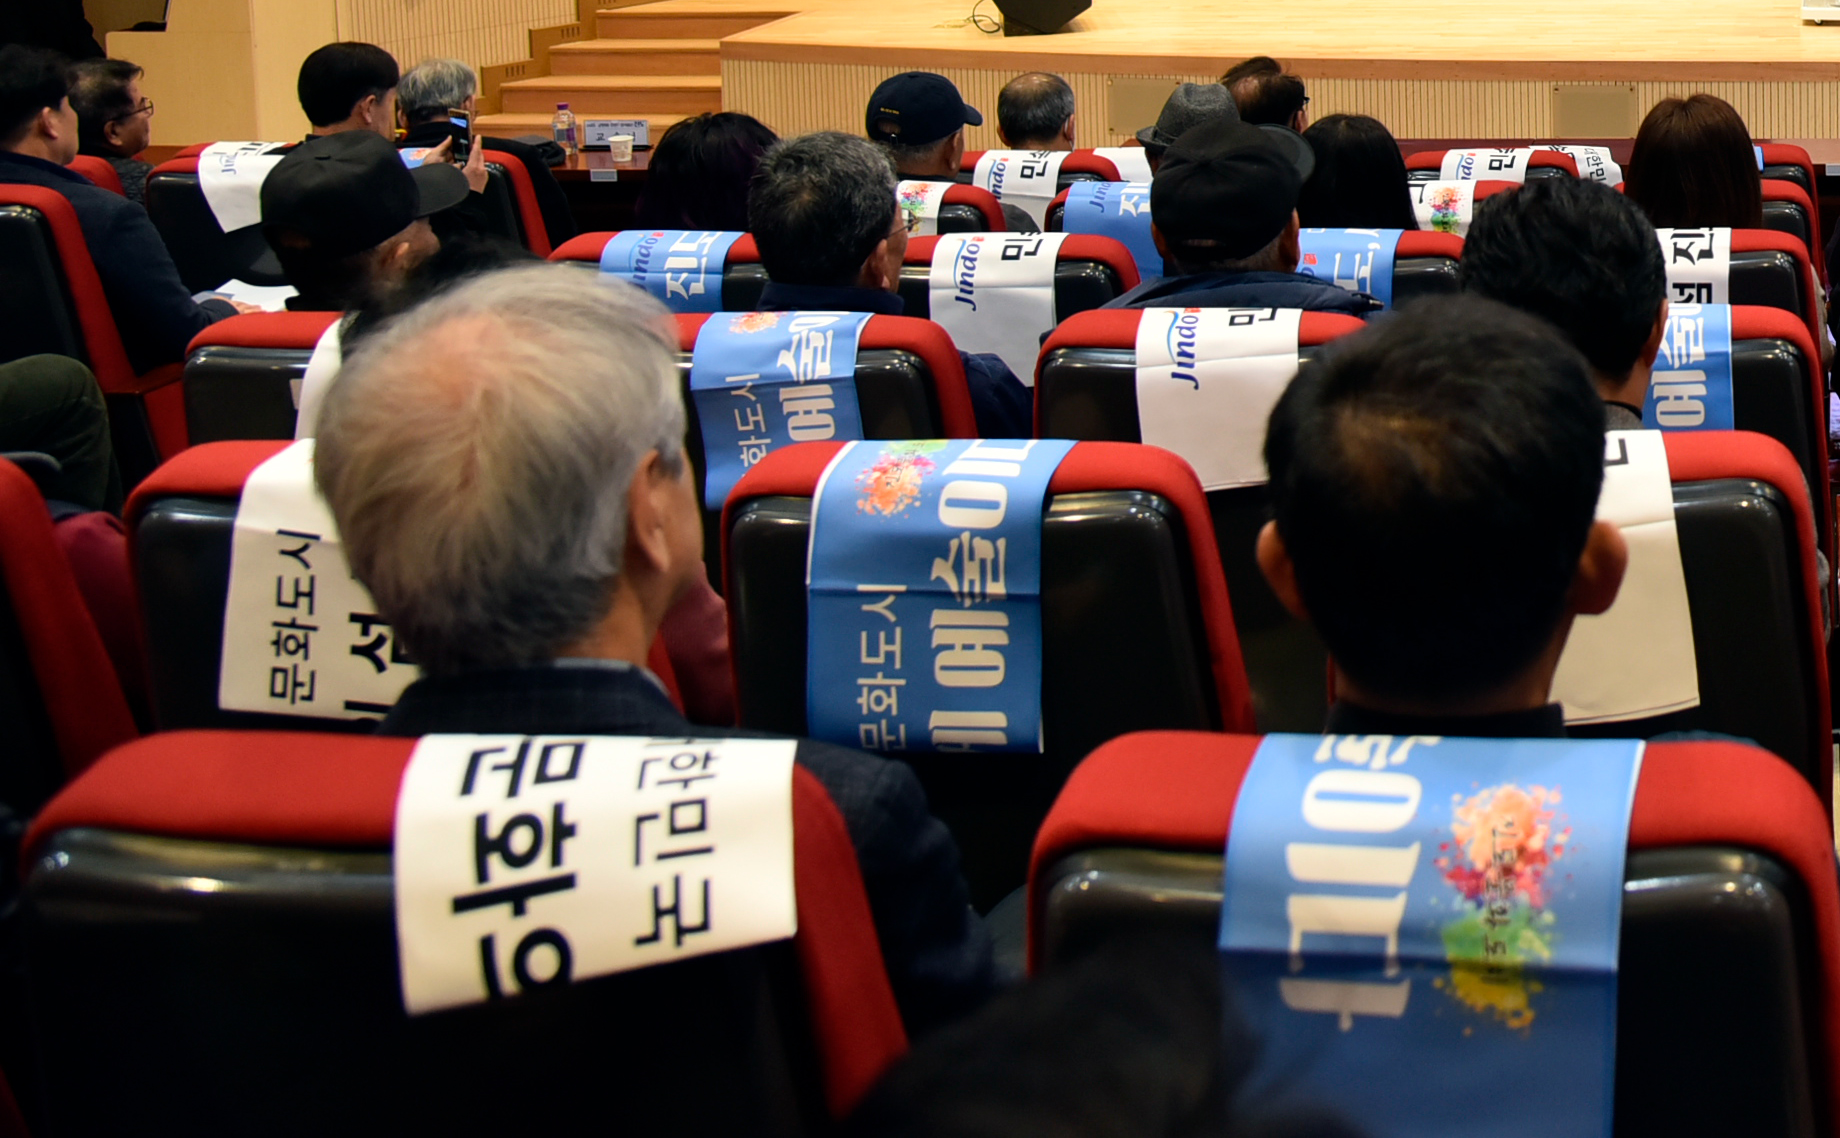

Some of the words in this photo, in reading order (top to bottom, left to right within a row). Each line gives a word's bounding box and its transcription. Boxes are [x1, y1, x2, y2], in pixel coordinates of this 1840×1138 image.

[955, 243, 981, 312] Jindo
[1171, 315, 1199, 391] Jindo
[270, 529, 321, 706] 문화도시
[634, 738, 722, 948] 한민국
